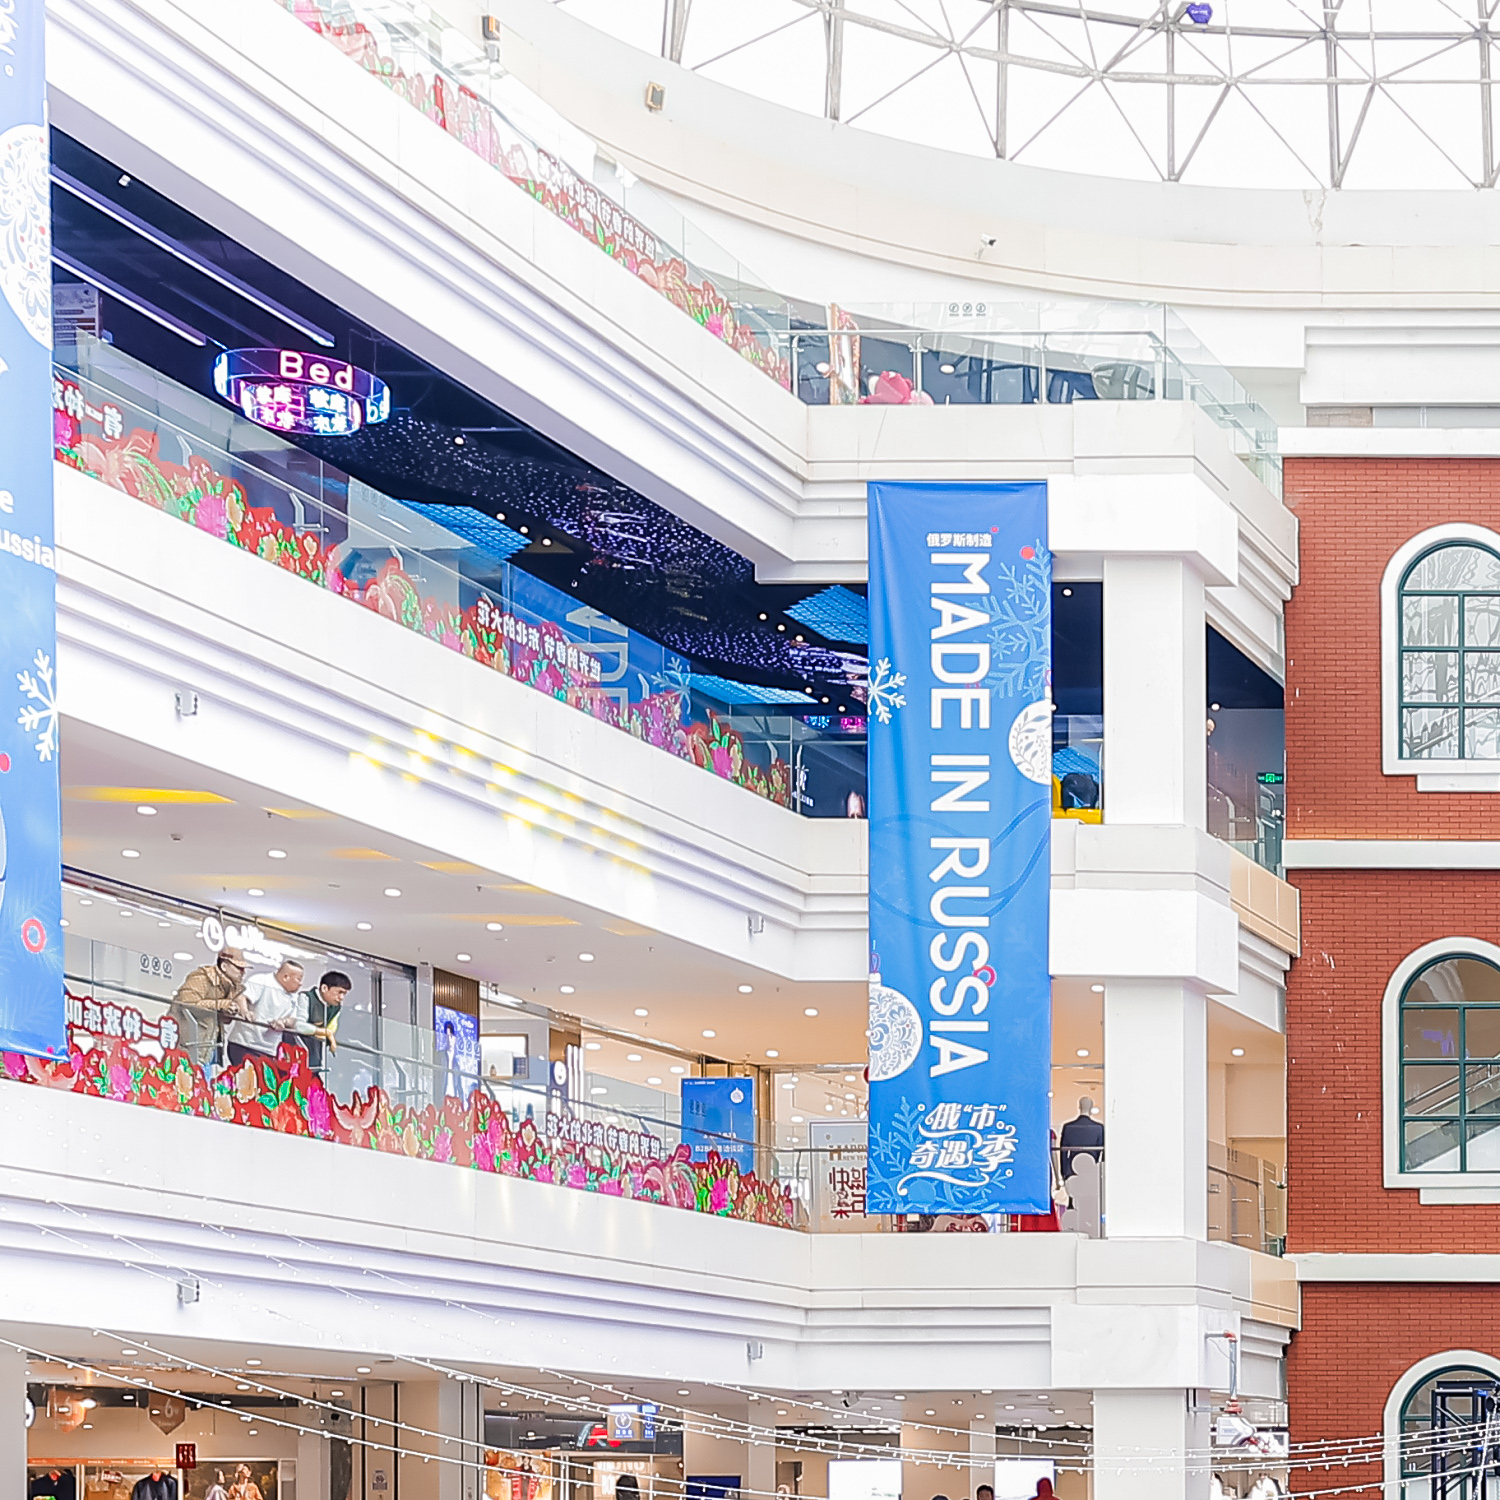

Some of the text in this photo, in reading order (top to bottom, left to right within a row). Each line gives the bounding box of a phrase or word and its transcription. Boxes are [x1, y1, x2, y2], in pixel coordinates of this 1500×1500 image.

[279, 350, 354, 391] Bed
[926, 533, 993, 548] 俄罗斯制造
[928, 552, 990, 1078] MADE IN RUSSIA
[909, 1133, 1019, 1174] 奇遇季
